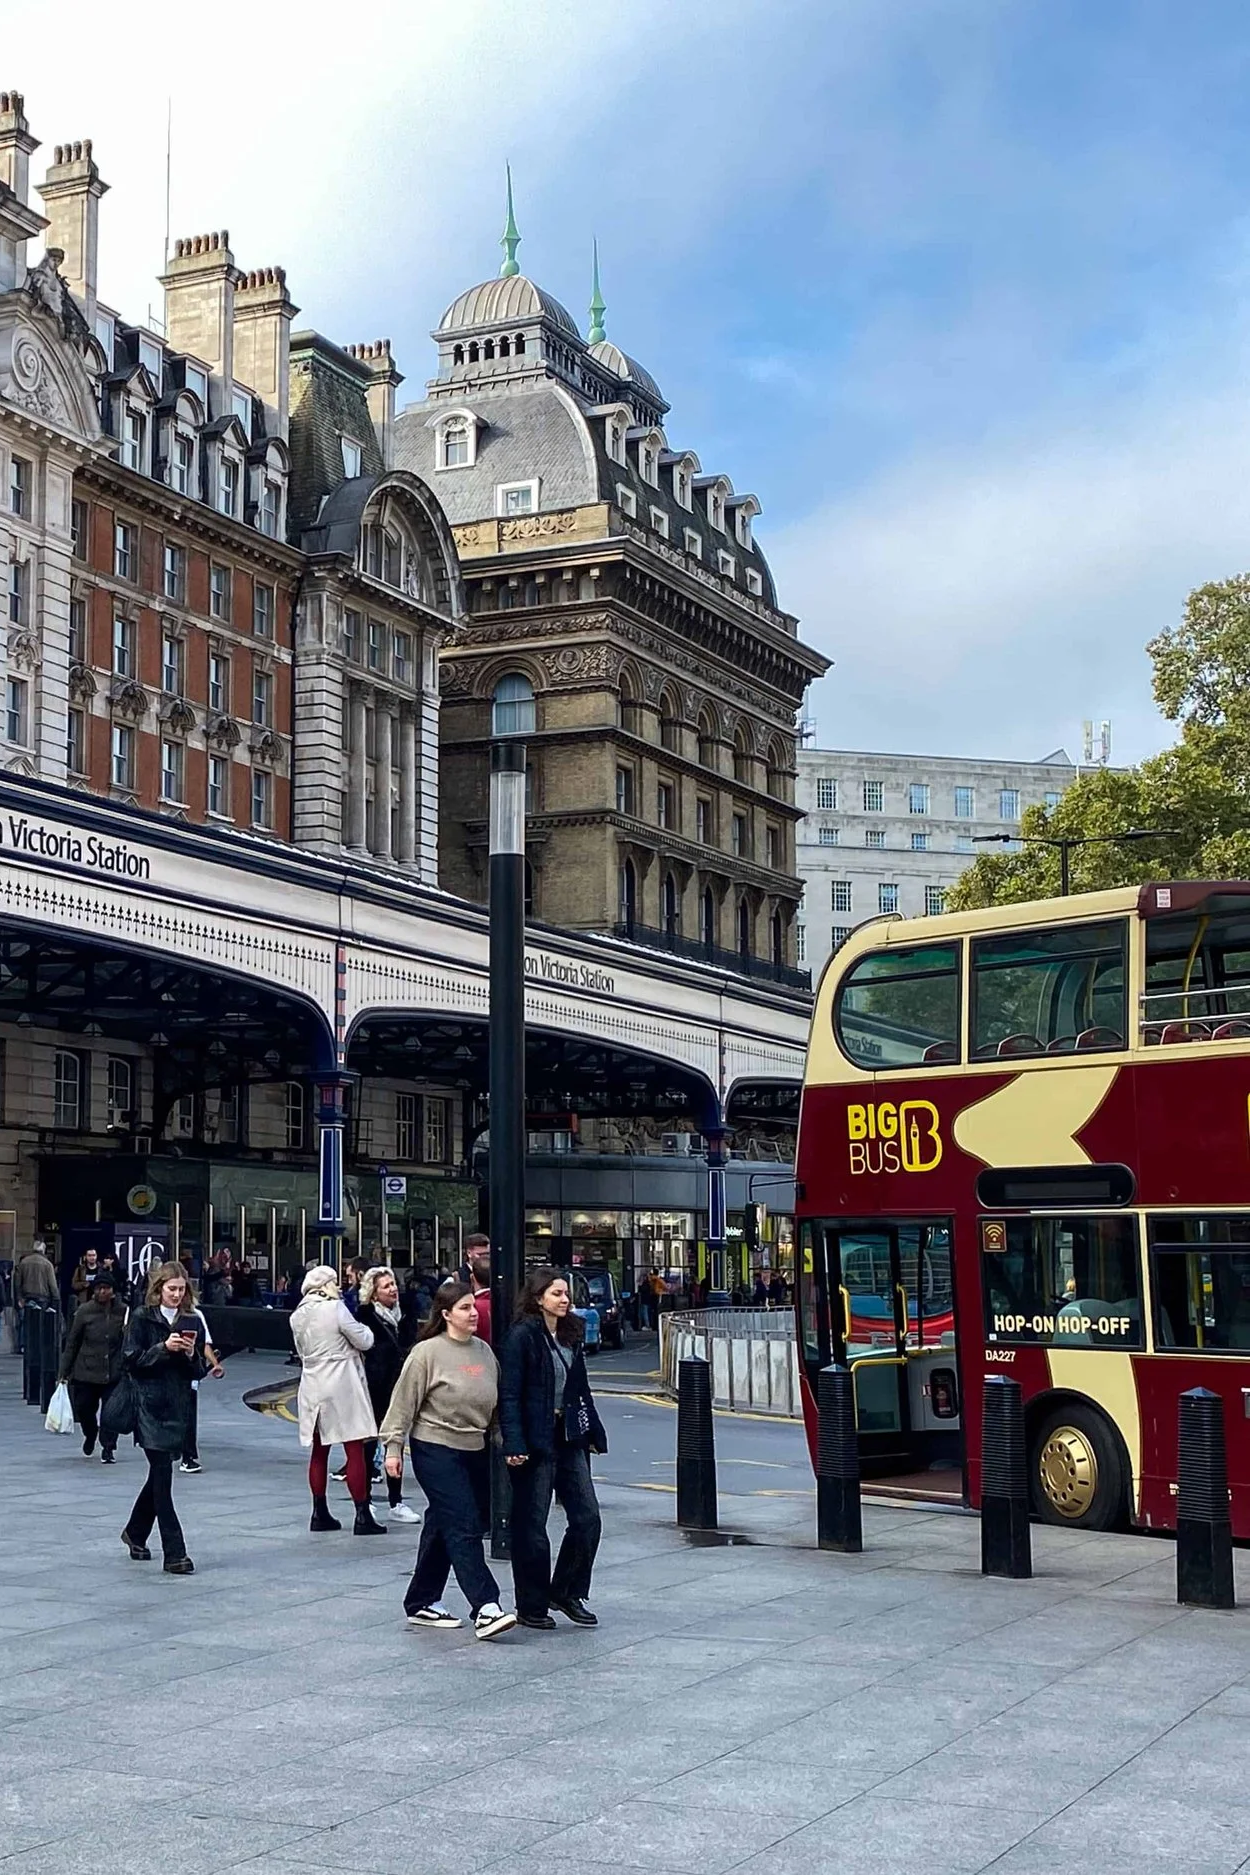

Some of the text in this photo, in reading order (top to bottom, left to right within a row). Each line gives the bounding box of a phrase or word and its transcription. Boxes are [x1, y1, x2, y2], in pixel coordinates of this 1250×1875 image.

[8, 815, 82, 863] Victoria
[86, 836, 151, 880] Station
[540, 953, 579, 986] Victoria
[579, 964, 615, 993] Station
[847, 1102, 898, 1140] BIG
[849, 1141, 901, 1175] BUS
[994, 1314, 1130, 1335] HOP-ON HOP-OFF
[985, 1349, 1016, 1362] DA227
